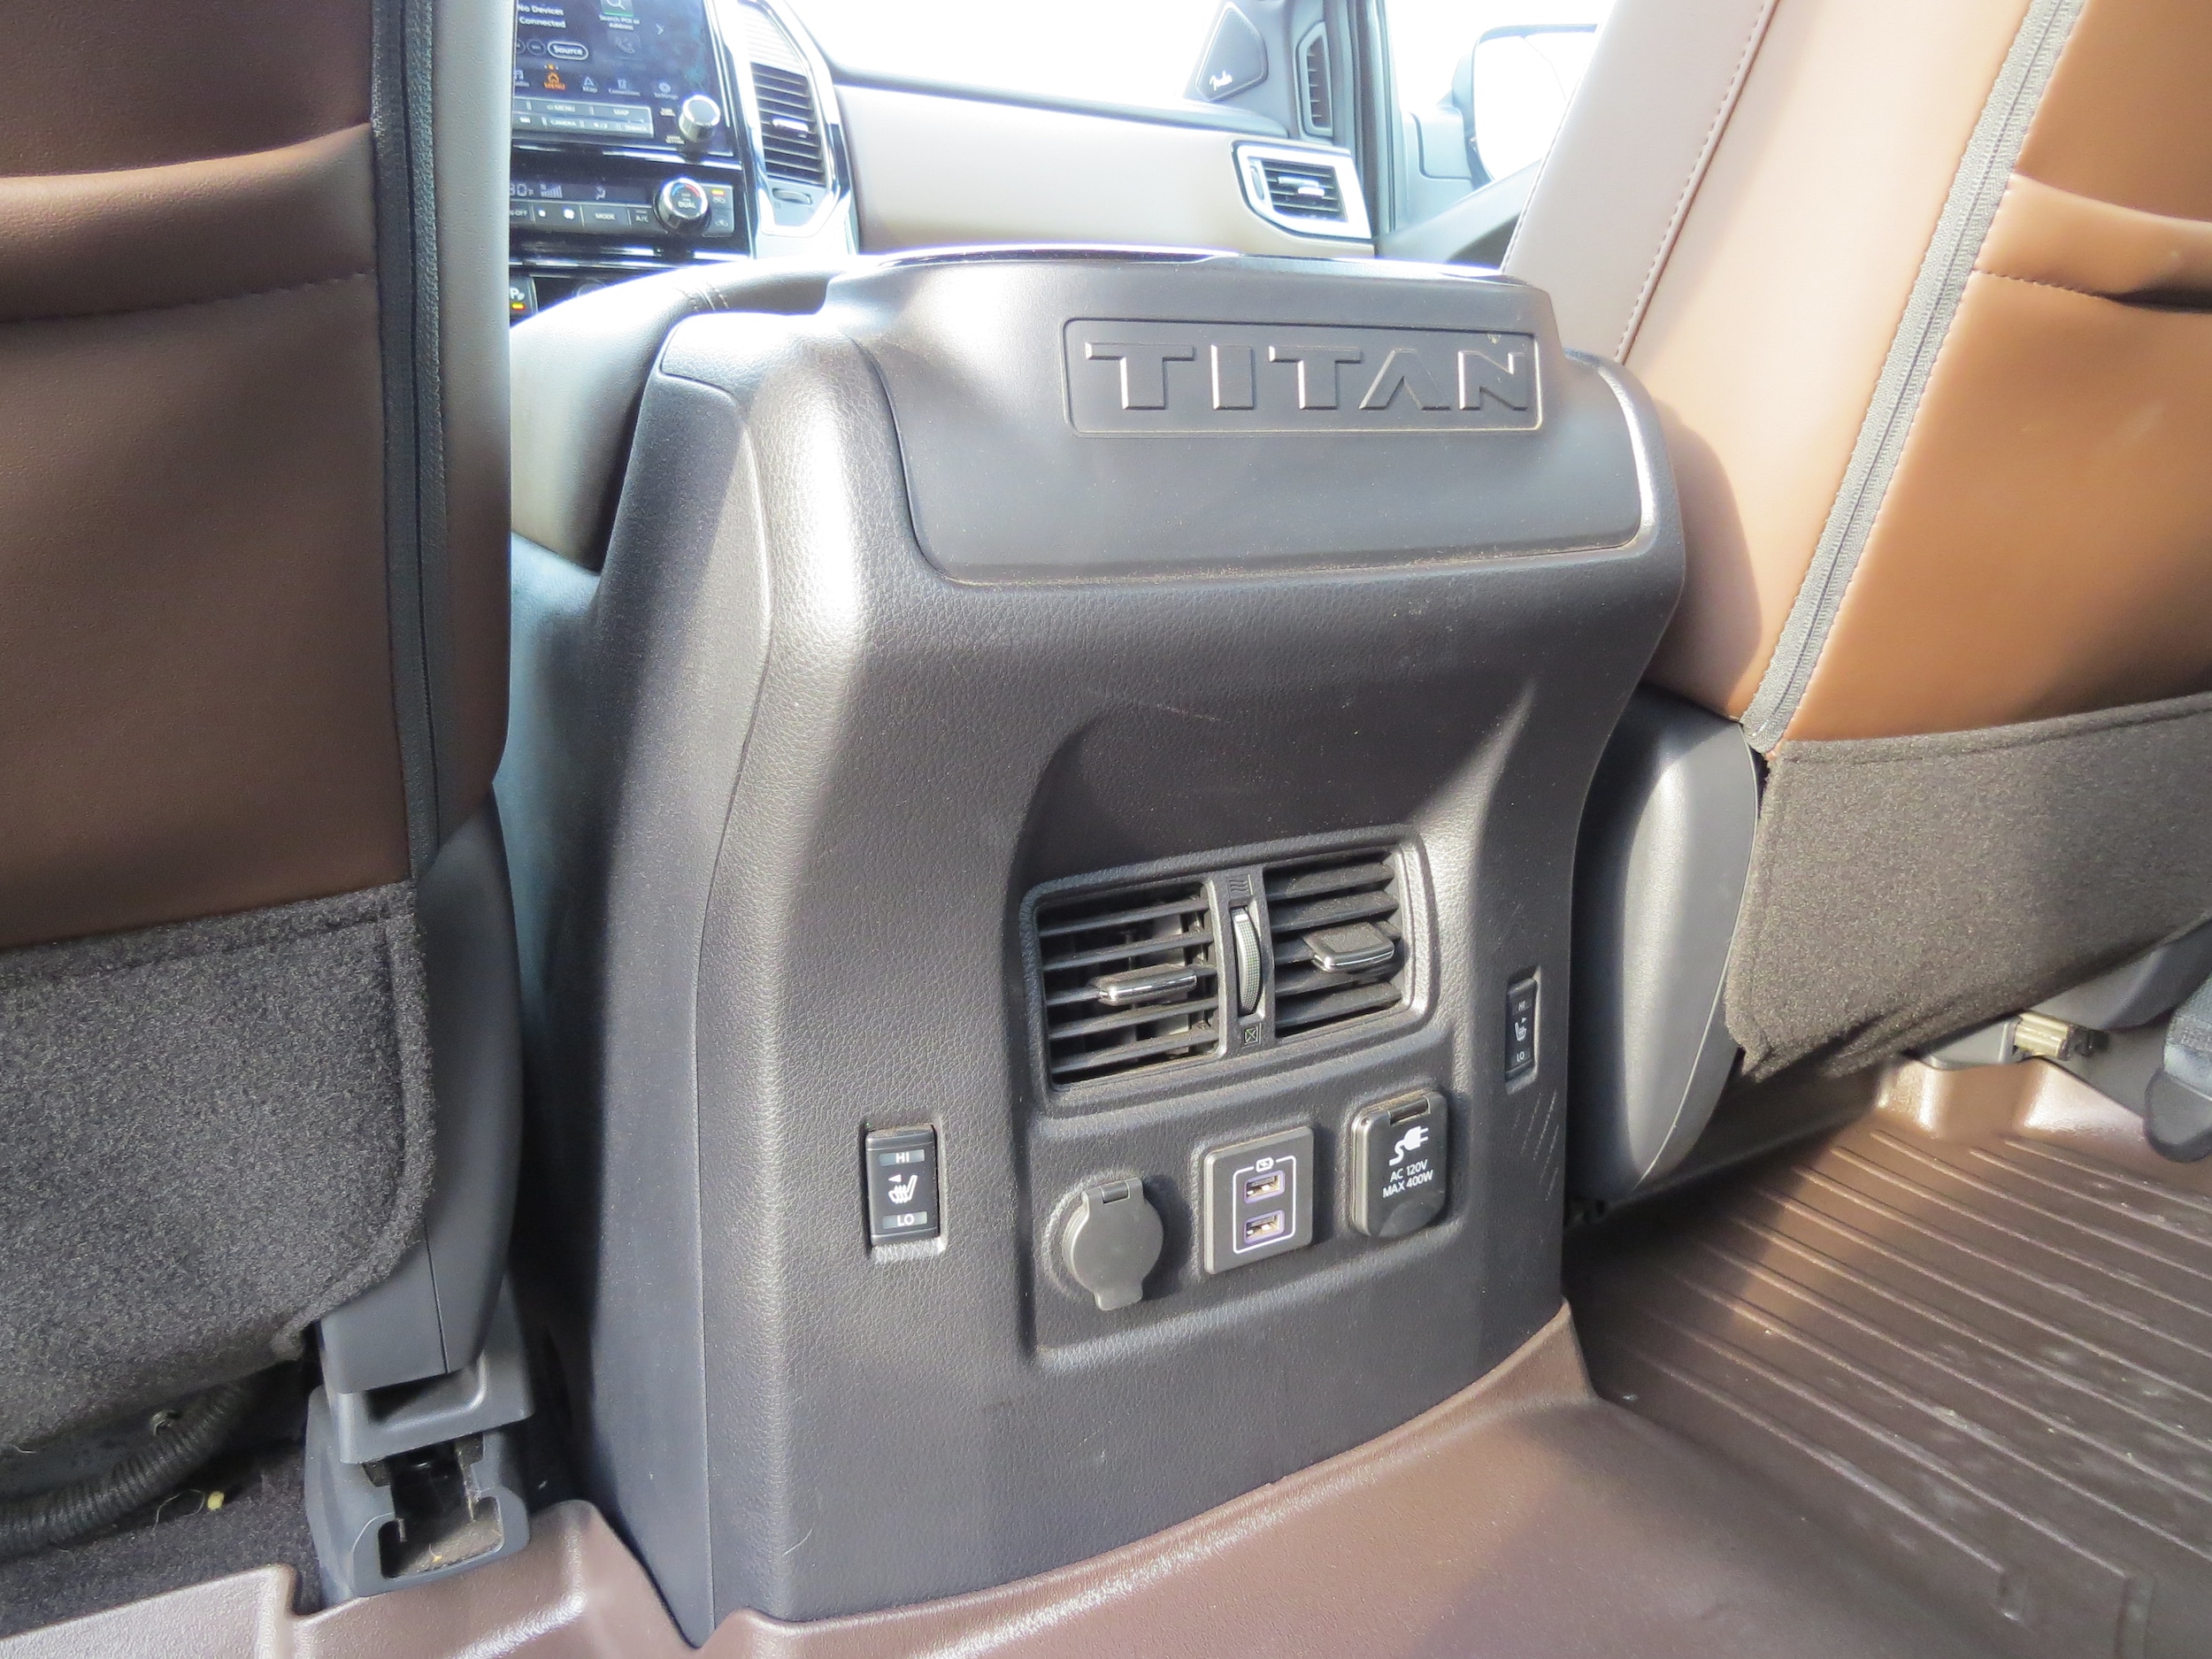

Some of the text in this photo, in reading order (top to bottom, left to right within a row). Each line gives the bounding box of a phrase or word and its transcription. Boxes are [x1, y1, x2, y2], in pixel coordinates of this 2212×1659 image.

[519, 17, 565, 27] Connected
[553, 45, 583, 55] Source
[678, 201, 697, 210] DUAL
[594, 212, 617, 221] MODE
[1085, 342, 1529, 411] TITAN
[1518, 1001, 1525, 1011] HI
[1517, 1051, 1525, 1062] LO
[896, 1152, 910, 1164] HI
[1389, 1159, 1428, 1183] AC 120V
[1382, 1170, 1433, 1198] MAX 400W
[896, 1214, 914, 1226] LO
